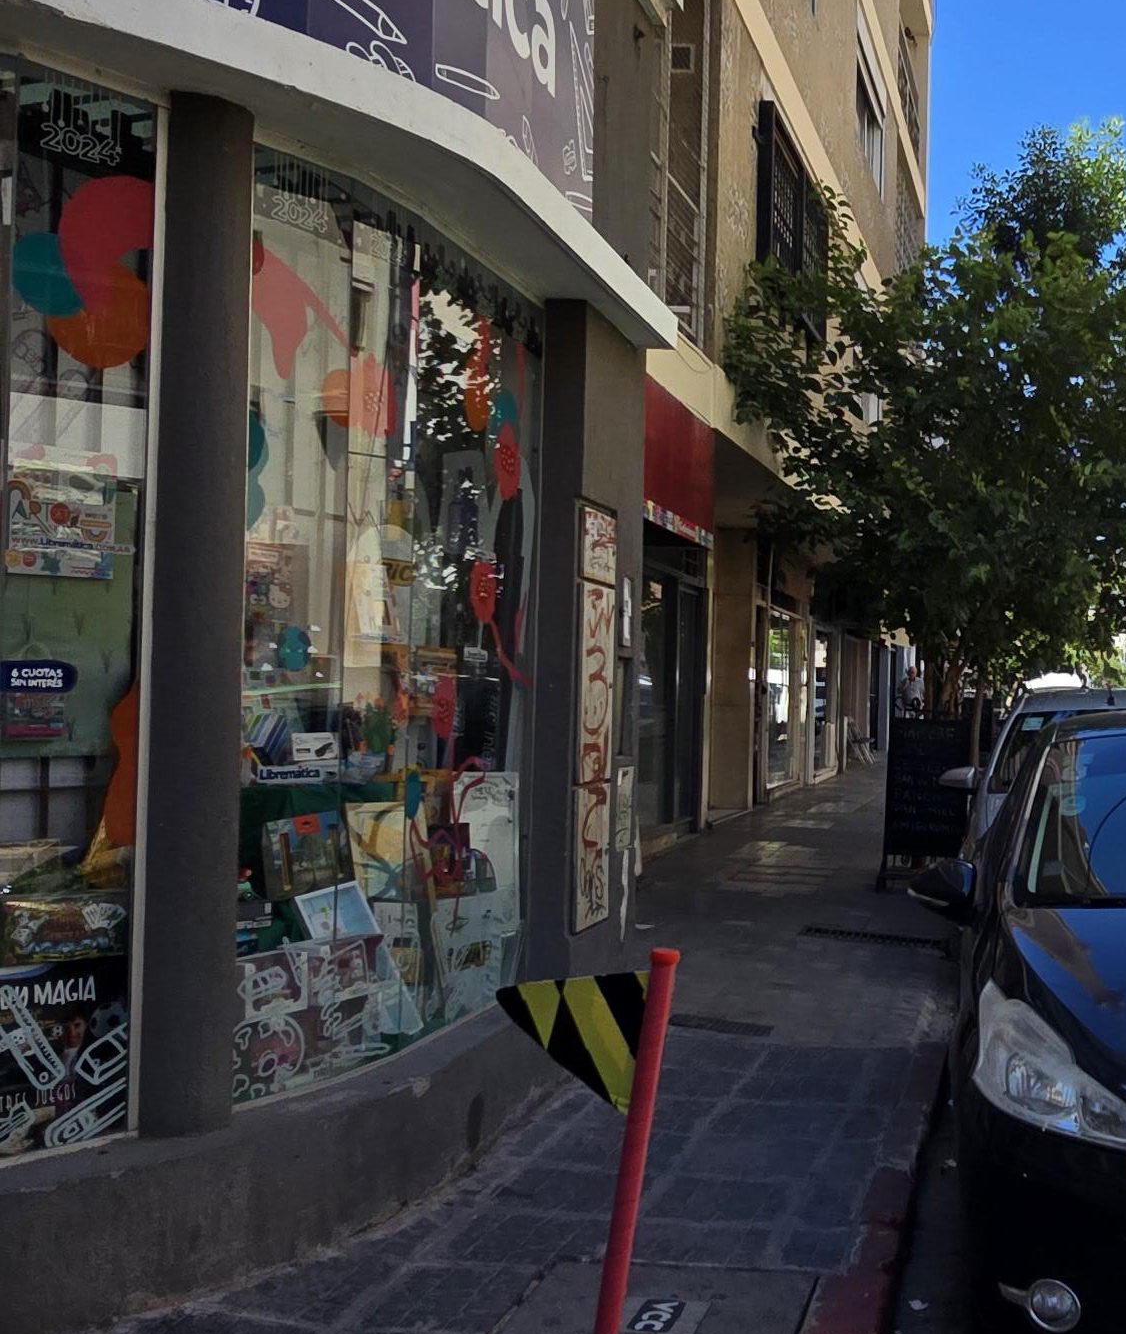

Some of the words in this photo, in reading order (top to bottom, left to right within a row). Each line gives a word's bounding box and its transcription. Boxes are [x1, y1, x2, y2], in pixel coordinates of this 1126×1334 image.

[40, 122, 119, 166] 2024
[271, 195, 329, 233] 2024
[10, 678, 27, 687] SIN
[28, 677, 63, 688] INTERÉS
[21, 668, 64, 678] CUOTAS
[33, 975, 96, 1005] MAGIA
[35, 1083, 76, 1107] JUEGOS
[634, 1301, 679, 1331] VCC
